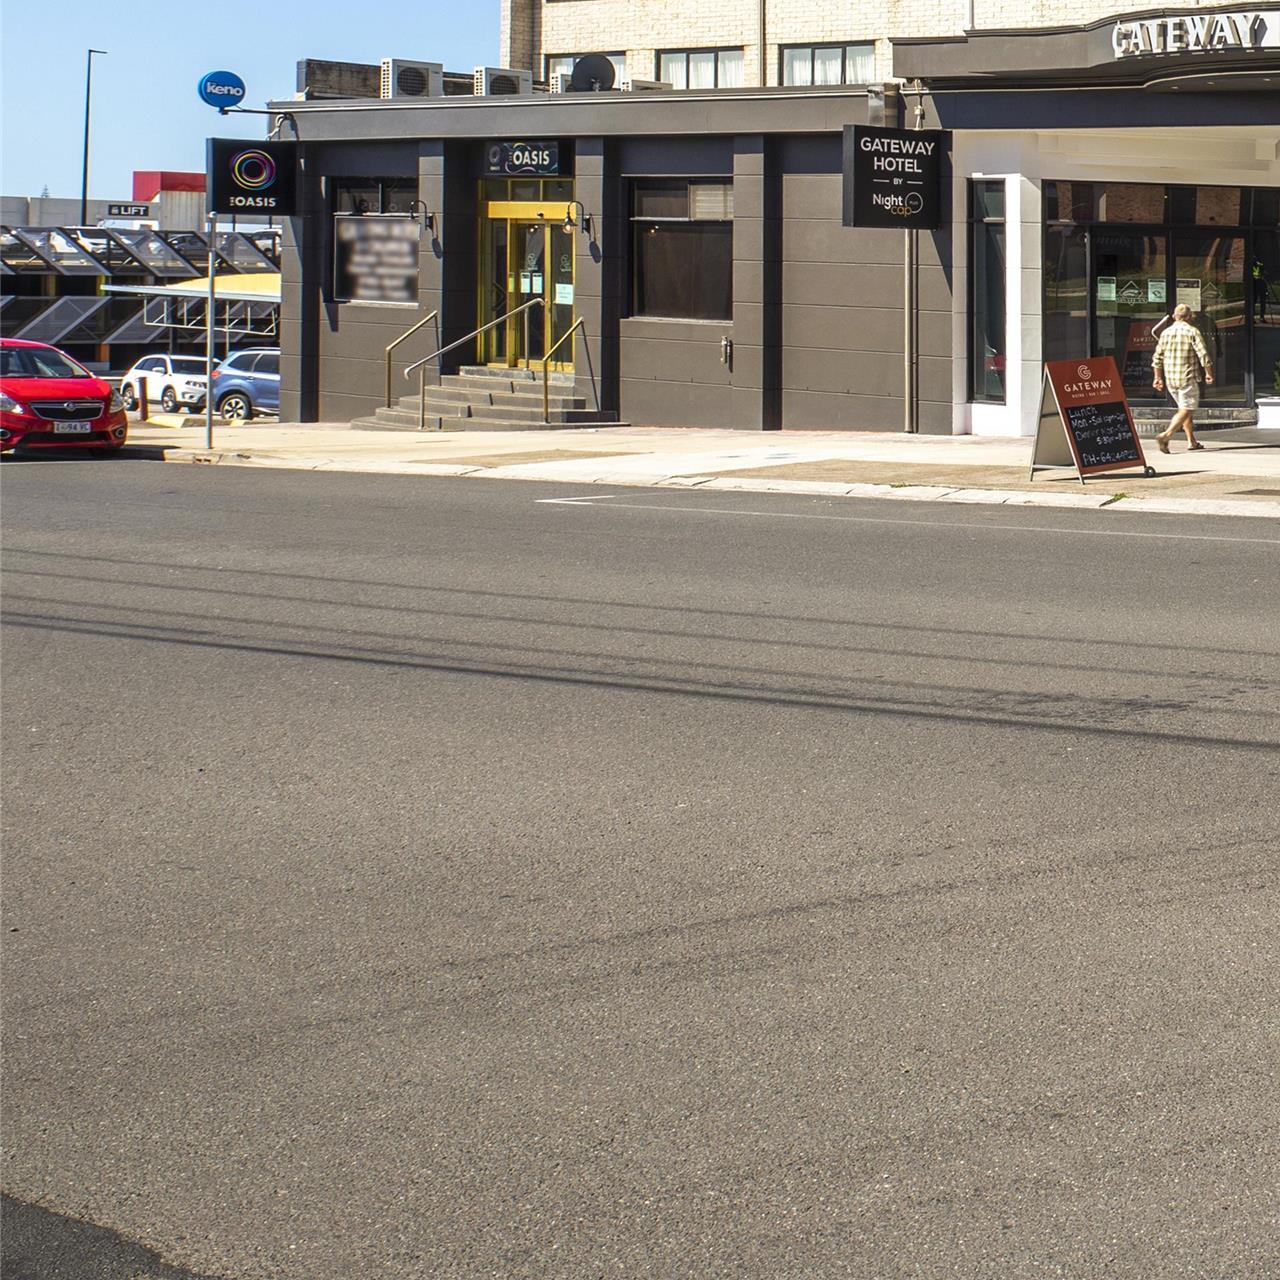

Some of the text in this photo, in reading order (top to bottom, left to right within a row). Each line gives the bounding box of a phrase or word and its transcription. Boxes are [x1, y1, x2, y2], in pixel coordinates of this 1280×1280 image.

[1111, 13, 1261, 56] GATEWAY
[860, 137, 935, 156] GATEWAY
[513, 150, 550, 165] OASIS
[874, 156, 922, 173] HOTEL
[893, 177, 904, 185] BY
[235, 196, 276, 207] OASIS
[873, 193, 903, 210] Night
[121, 206, 146, 215] LIFT
[1064, 380, 1112, 392] GATEWAY
